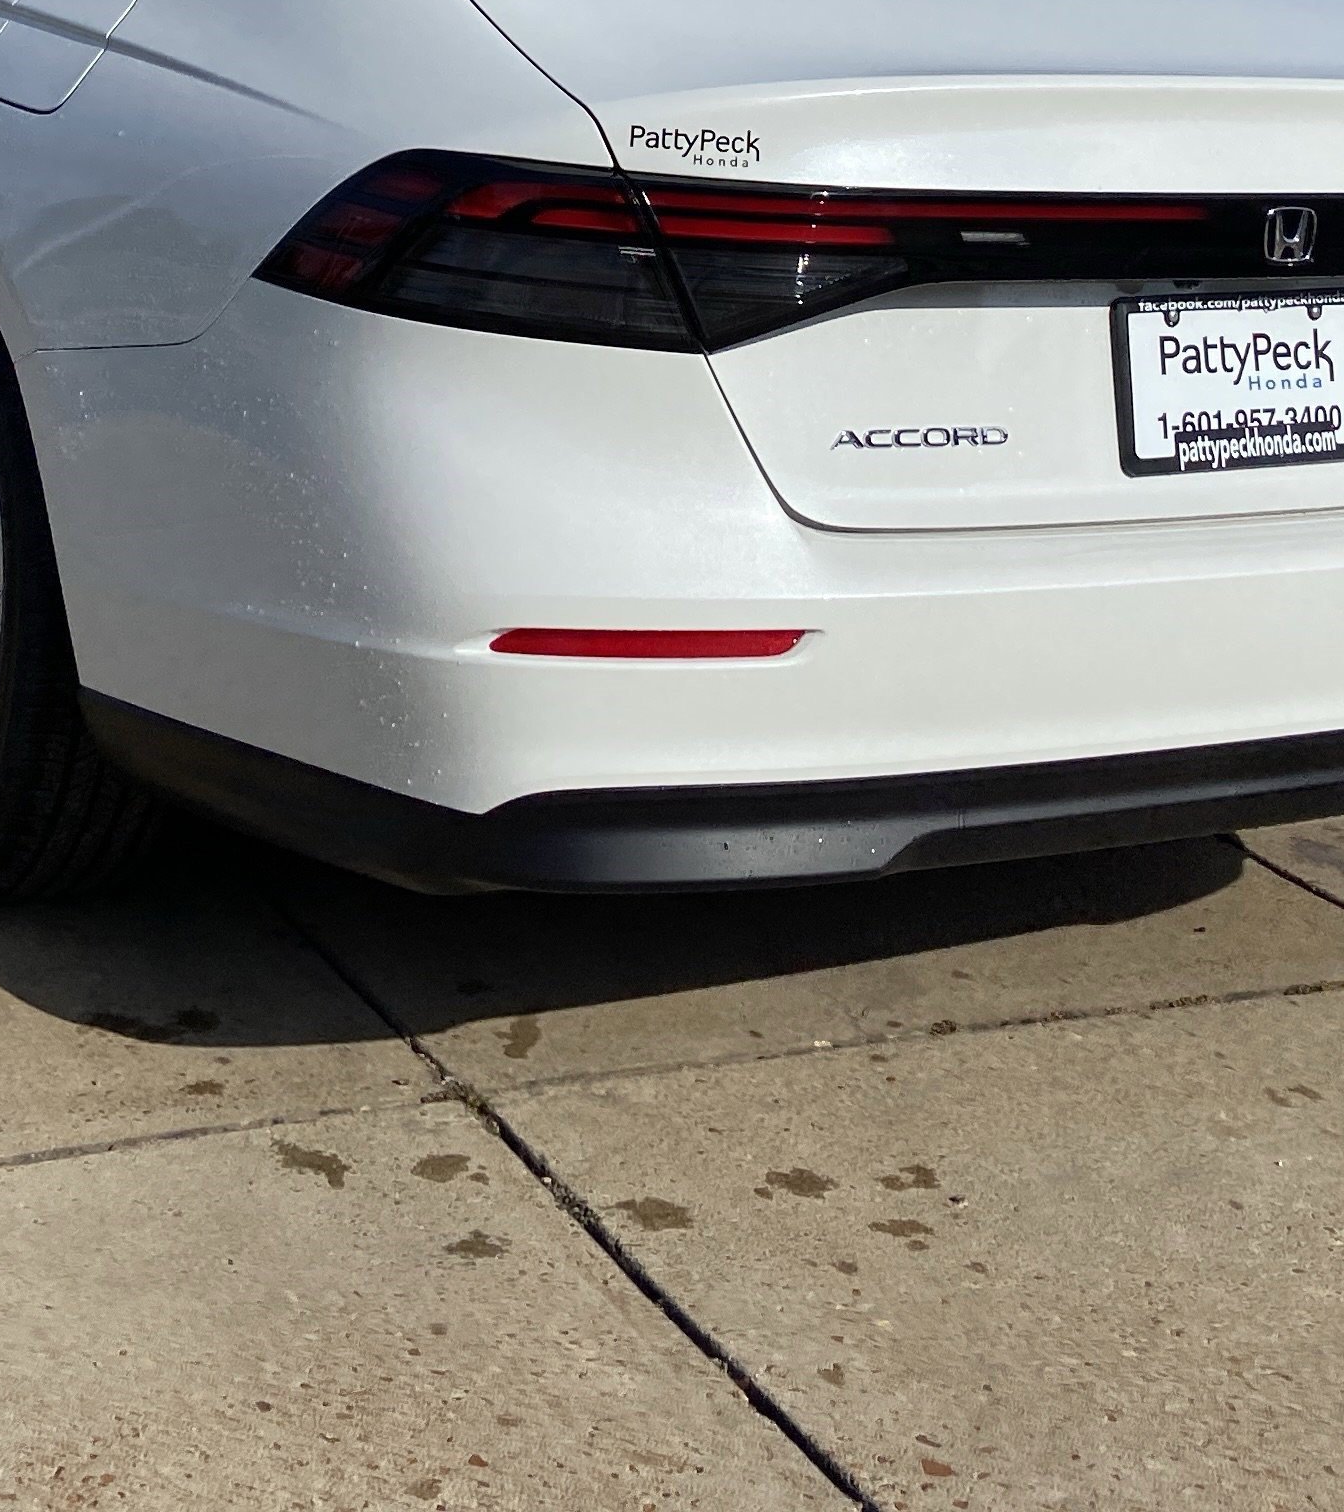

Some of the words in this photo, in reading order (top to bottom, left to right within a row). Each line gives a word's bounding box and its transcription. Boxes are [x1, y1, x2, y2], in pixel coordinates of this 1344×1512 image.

[629, 125, 760, 161] PattyPeck
[693, 155, 749, 168] Honda
[1158, 328, 1335, 385] PattyPeck
[1249, 374, 1323, 391] Honda
[829, 426, 1009, 450] ACCORD
[1178, 425, 1337, 471] pattypeckhonda.com
